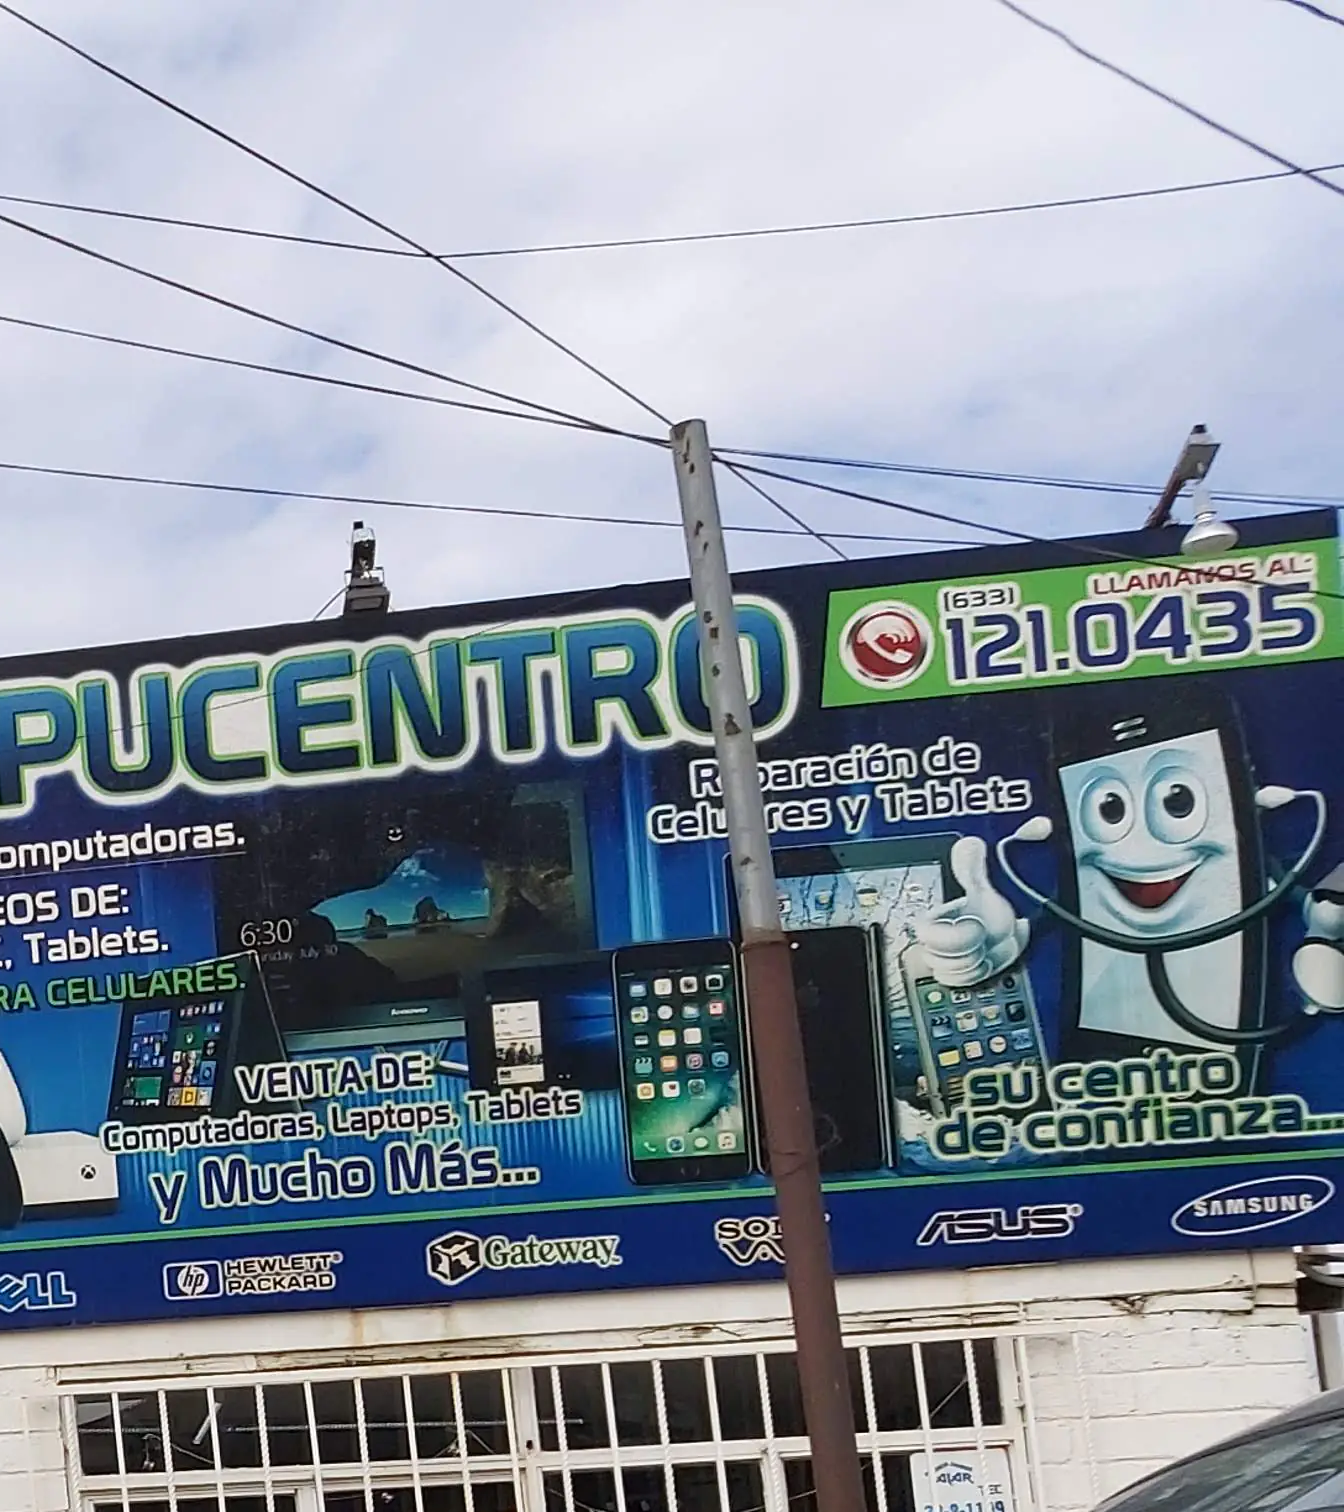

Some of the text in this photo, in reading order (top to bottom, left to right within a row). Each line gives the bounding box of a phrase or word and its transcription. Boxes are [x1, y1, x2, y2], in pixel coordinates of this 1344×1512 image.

[1093, 561, 1256, 596] LLAMANOS
[944, 580, 1319, 684] 121.0435
[691, 736, 981, 799] Rparación de
[647, 777, 1033, 844] Celures y Tablets
[71, 883, 131, 920] DE:
[23, 925, 170, 966] Tablets.
[240, 918, 293, 947] 6:30
[46, 962, 247, 1007] CELULARES.
[236, 1053, 434, 1103] VENTA DE:
[967, 1049, 1240, 1109] su centro
[100, 1087, 583, 1155] Computadoras, Laptops, Tablets
[932, 1106, 1013, 1160] de
[151, 1141, 542, 1224] y Mucho Más...
[917, 1204, 1075, 1246] ASUS
[1192, 1192, 1316, 1219] SAMSUNG
[223, 1252, 334, 1277] HEWLETT
[483, 1235, 622, 1270] Gateway
[226, 1275, 335, 1296] PACKARD
